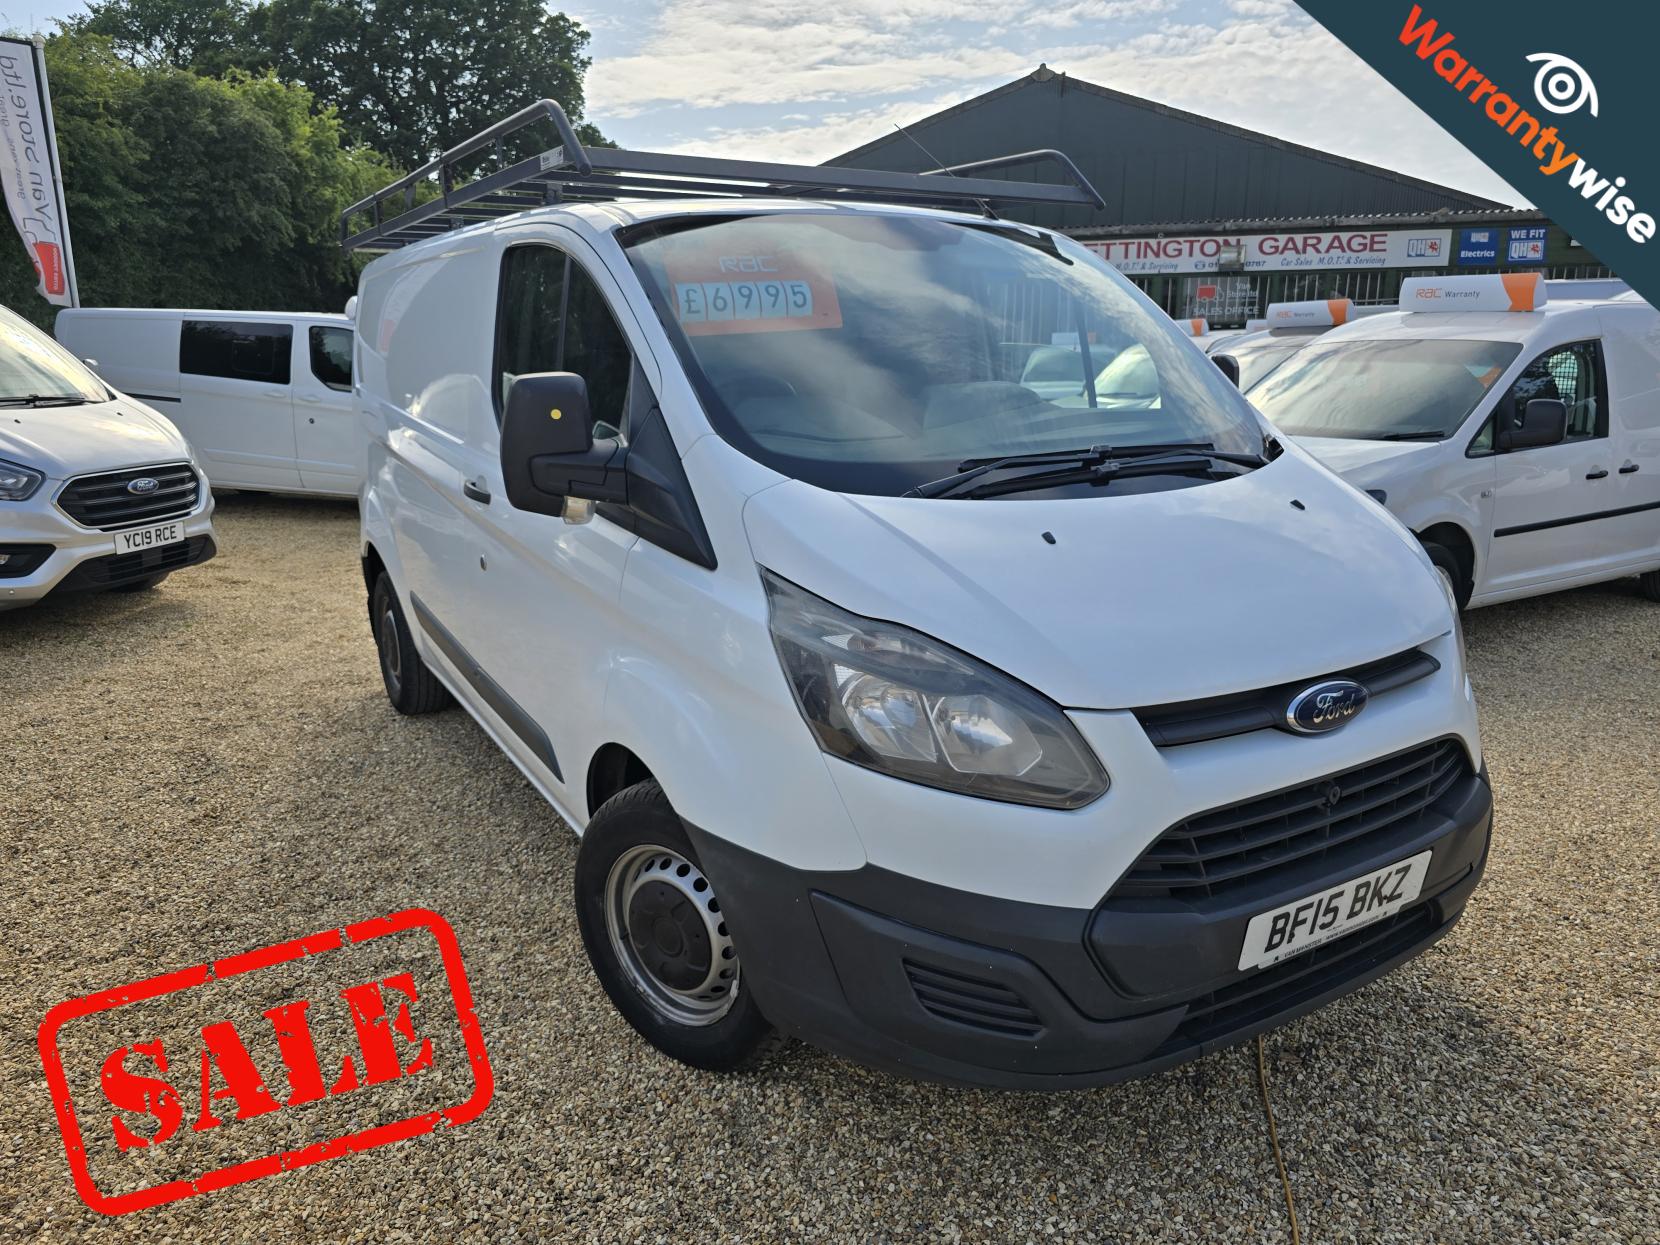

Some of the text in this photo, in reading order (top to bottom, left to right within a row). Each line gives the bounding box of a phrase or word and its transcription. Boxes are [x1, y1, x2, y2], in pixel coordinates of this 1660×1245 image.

[1511, 229, 1545, 239] WE FIT
[1258, 233, 1388, 256] GARAGE
[1280, 258, 1293, 266] Car
[1294, 257, 1312, 266] Sales
[1353, 256, 1386, 266] Servicing
[1460, 250, 1495, 258] Electrics
[684, 284, 807, 314] £6995
[1444, 290, 1481, 298] Warranty
[1193, 306, 1260, 316] SALES OFFICE
[124, 525, 177, 549] YC19 RCE
[1313, 690, 1355, 723] Ford
[1264, 864, 1412, 953] BF15 BKZ
